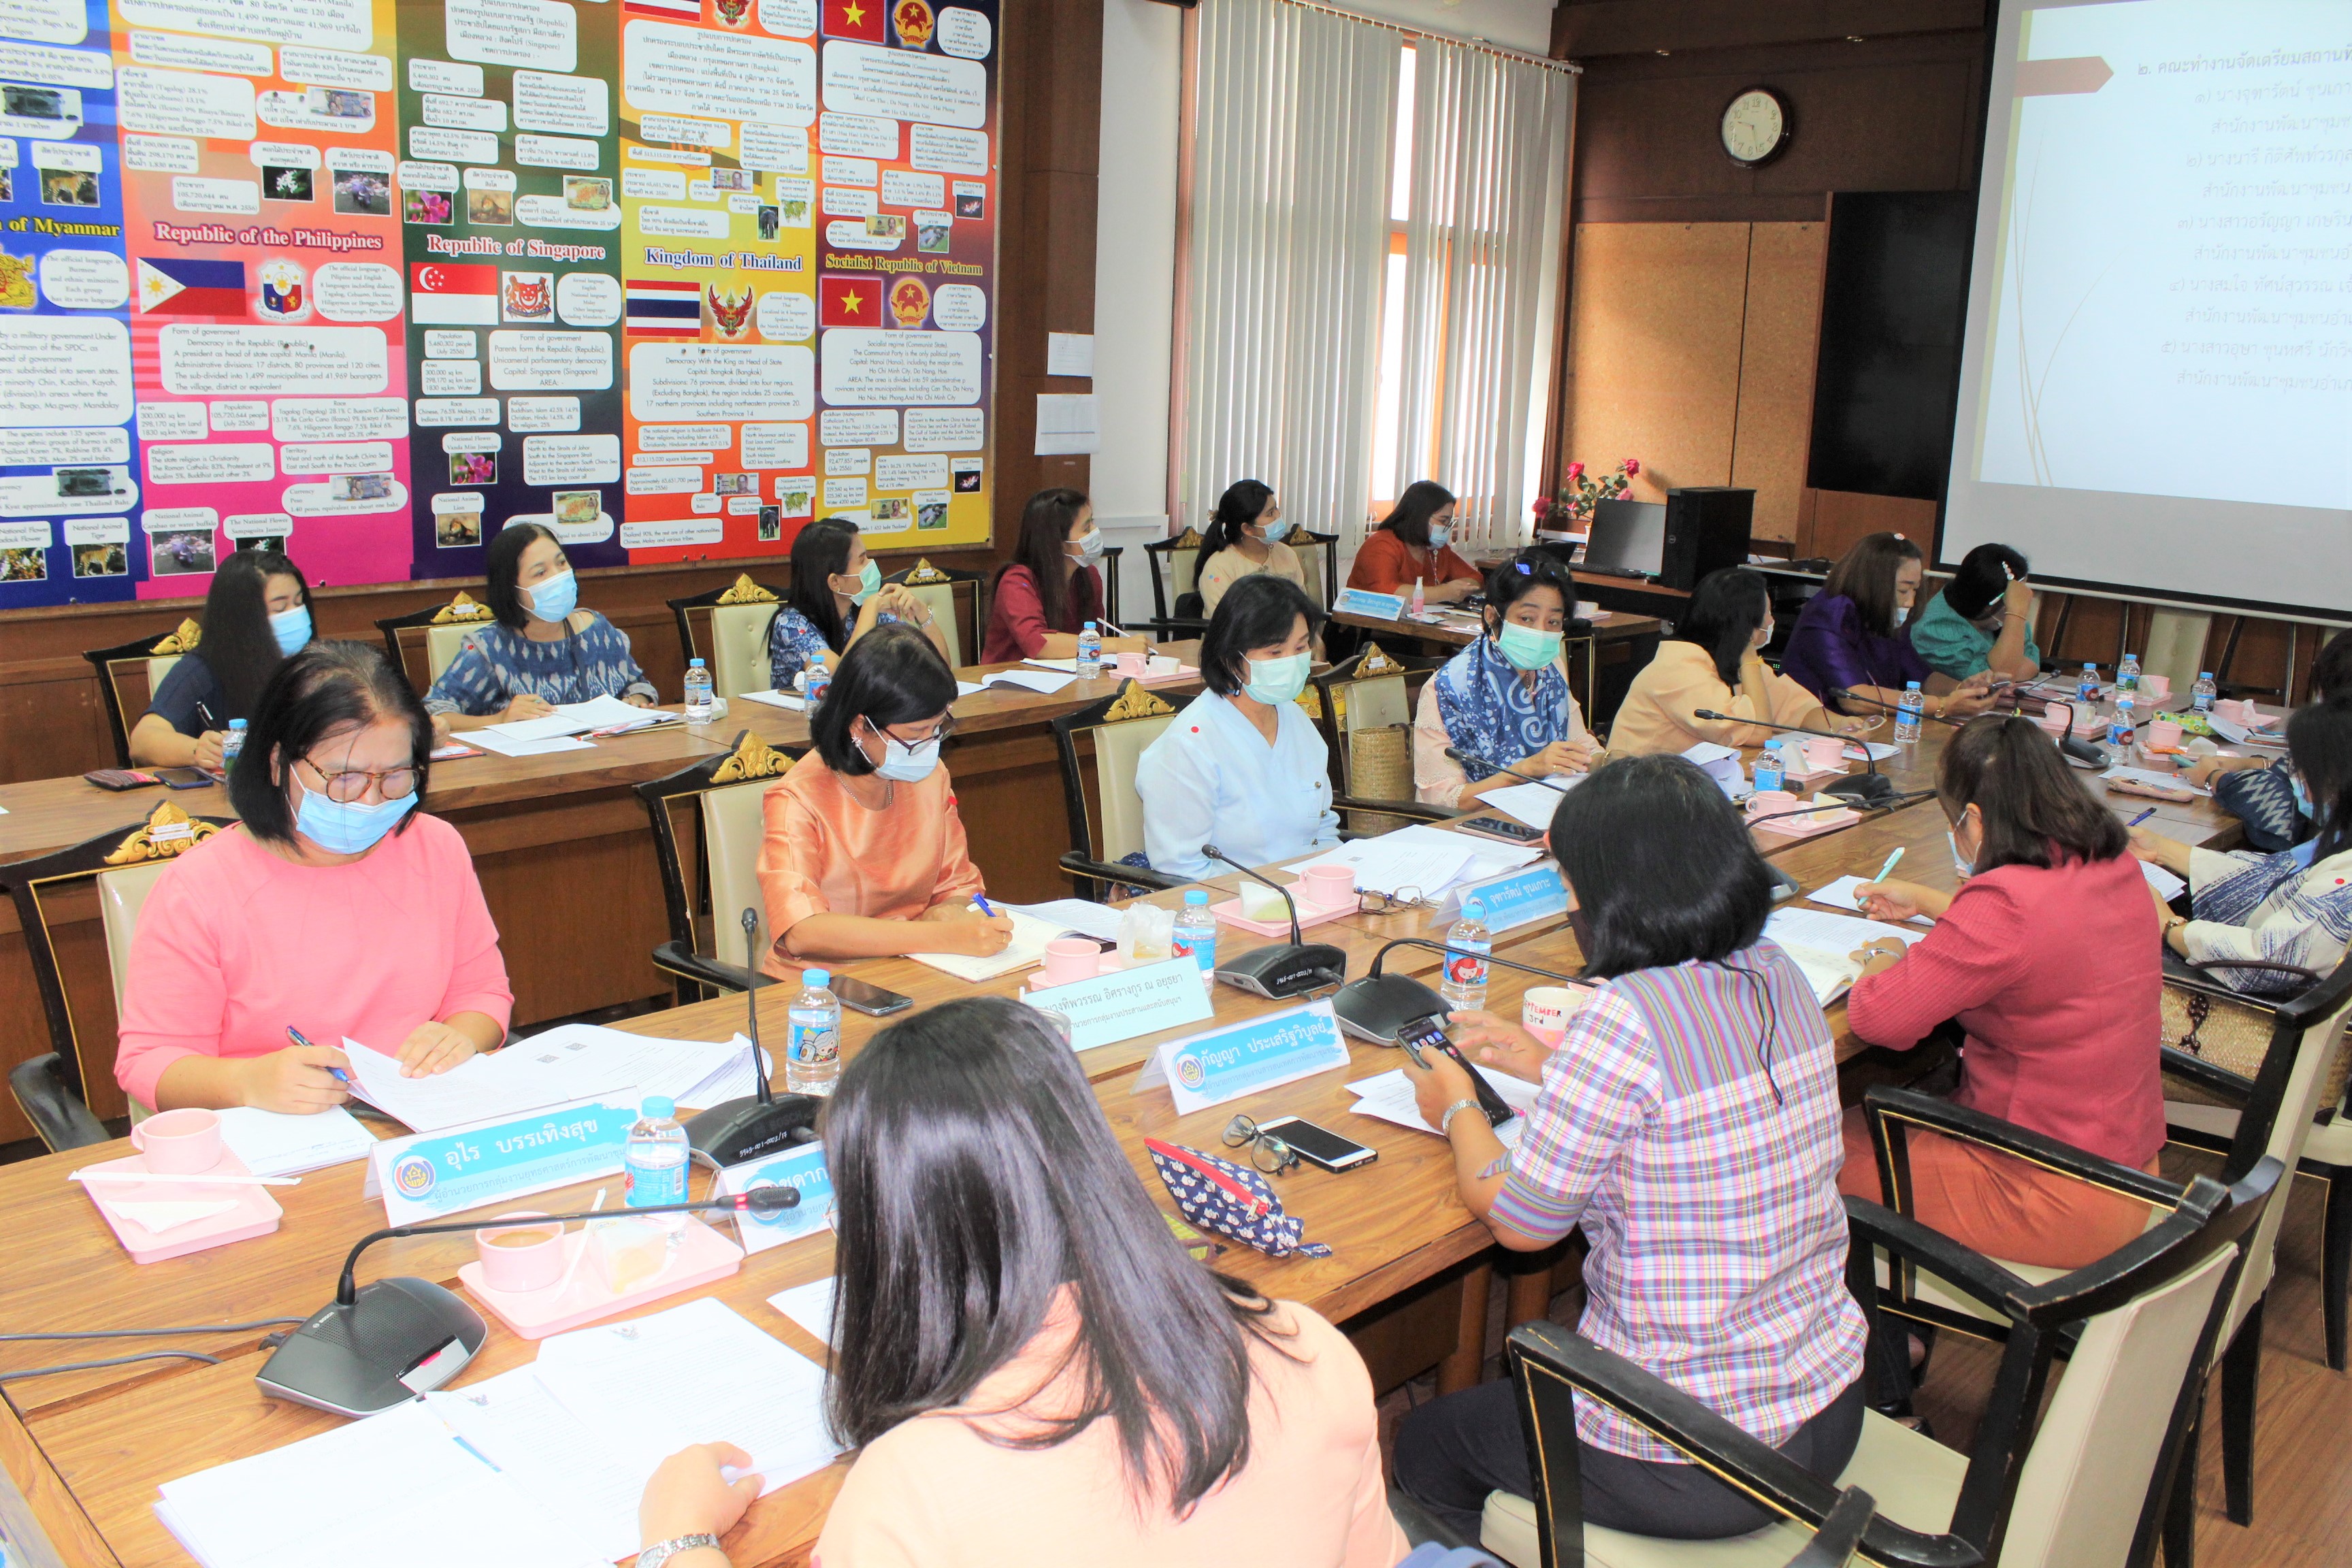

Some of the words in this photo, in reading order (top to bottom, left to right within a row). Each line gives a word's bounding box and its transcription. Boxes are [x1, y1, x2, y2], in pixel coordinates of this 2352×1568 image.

[536, 18, 568, 27] (Republic)
[525, 39, 560, 50] (Singapore)
[751, 63, 779, 73] (Bangkok)
[10, 218, 29, 233] of
[34, 218, 120, 238] Myanmar
[154, 223, 234, 246] Republic
[240, 227, 259, 245] of
[265, 229, 288, 246] the
[294, 230, 382, 250] Philippines
[427, 234, 502, 257] Republic
[506, 237, 523, 256] of
[528, 240, 606, 260] Singapore
[645, 247, 715, 267] Kingdom
[719, 251, 735, 268] of
[739, 252, 802, 271] Thailand
[826, 255, 872, 269] Socialist
[876, 256, 923, 274] Republic
[926, 260, 938, 274] of
[940, 260, 983, 276] Vietnam
[201, 328, 240, 338] government
[546, 334, 582, 343] government
[546, 346, 572, 355] Republic
[574, 346, 606, 355] (Republic).
[721, 348, 752, 356] government
[530, 357, 573, 366] parliamentary
[574, 357, 607, 366] democracy
[666, 358, 696, 366] Democracy
[723, 358, 736, 366] King
[504, 368, 527, 377] Capital:
[529, 368, 561, 377] Singapore
[563, 368, 598, 377] (Singapore)
[687, 368, 708, 376] Capital:
[710, 368, 734, 376] Bangkok
[1145, 981, 1154, 992] ณ
[1157, 973, 1183, 990] อยุธยา
[1529, 1014, 1544, 1025] 3rd
[1200, 1045, 1241, 1068] กัญญา
[445, 1141, 480, 1170] อุไร
[495, 1118, 599, 1154] บรรเทิงสุข
[434, 1147, 625, 1203] ผู้อำนวยการกลุ่มงานยุทธศาสตร์การพัฒนาชุม
[782, 1201, 829, 1225] ผู้อำนวยกา
